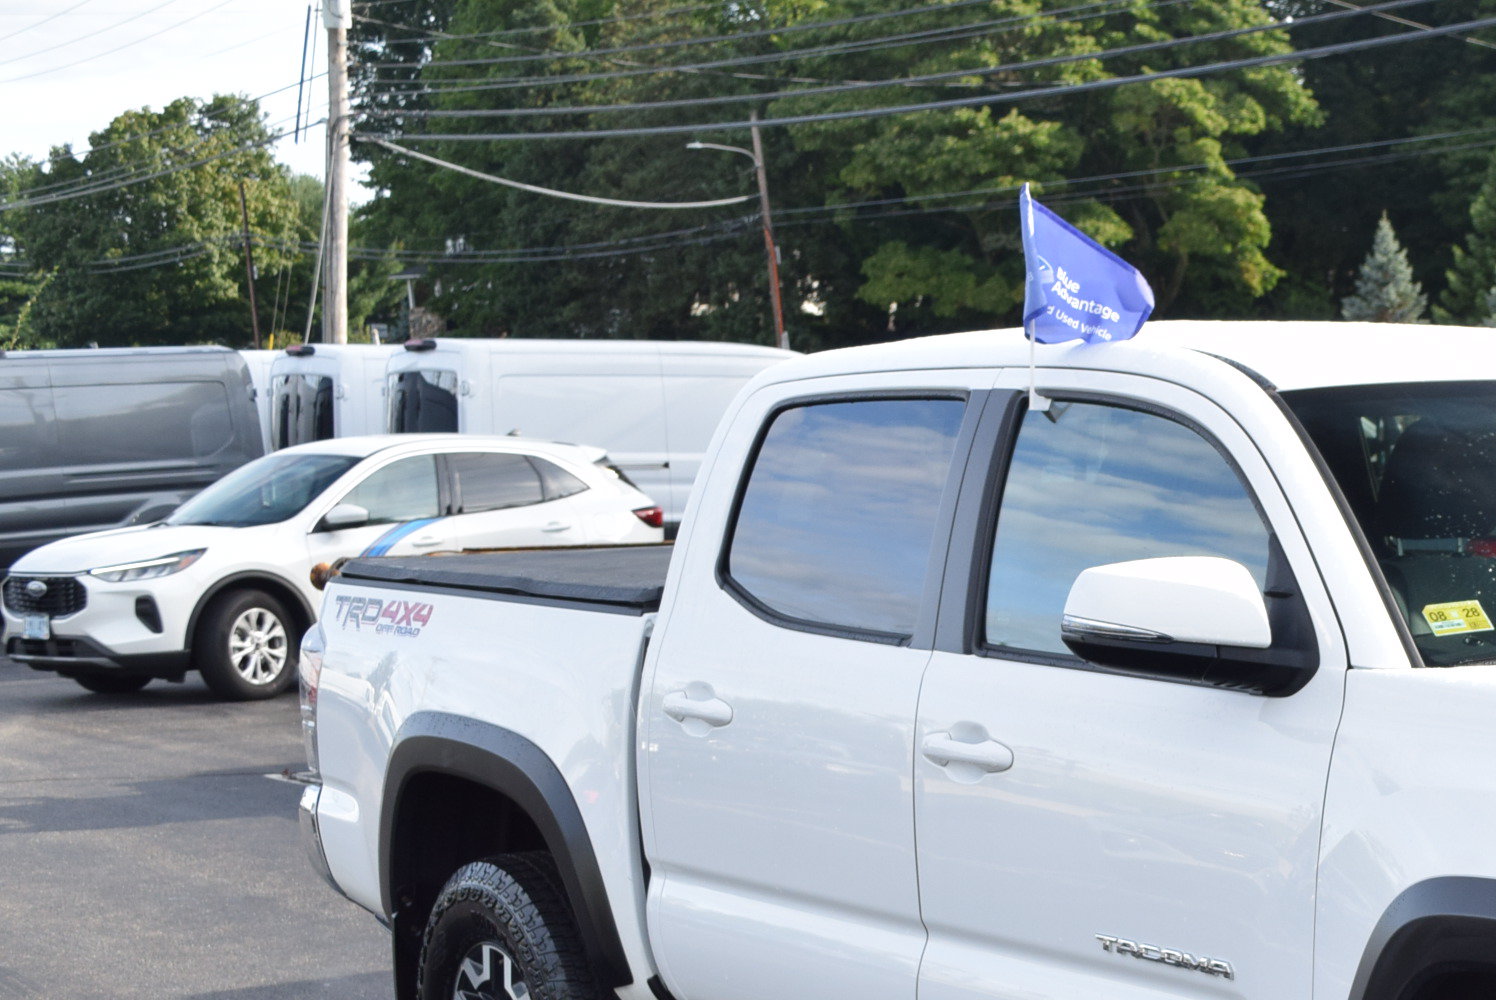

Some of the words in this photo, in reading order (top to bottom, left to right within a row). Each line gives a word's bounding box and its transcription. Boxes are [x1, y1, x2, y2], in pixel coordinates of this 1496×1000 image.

[1056, 266, 1080, 294] Blue
[1051, 281, 1120, 323] Advantage
[1056, 308, 1080, 329] Used
[1080, 322, 1113, 341] Vehicle
[336, 595, 383, 632] TRD
[1429, 611, 1447, 622] 08
[1462, 607, 1480, 618] 28
[376, 624, 394, 635] OFF
[394, 626, 421, 637] ROAD
[1094, 932, 1235, 981] TACOMA
